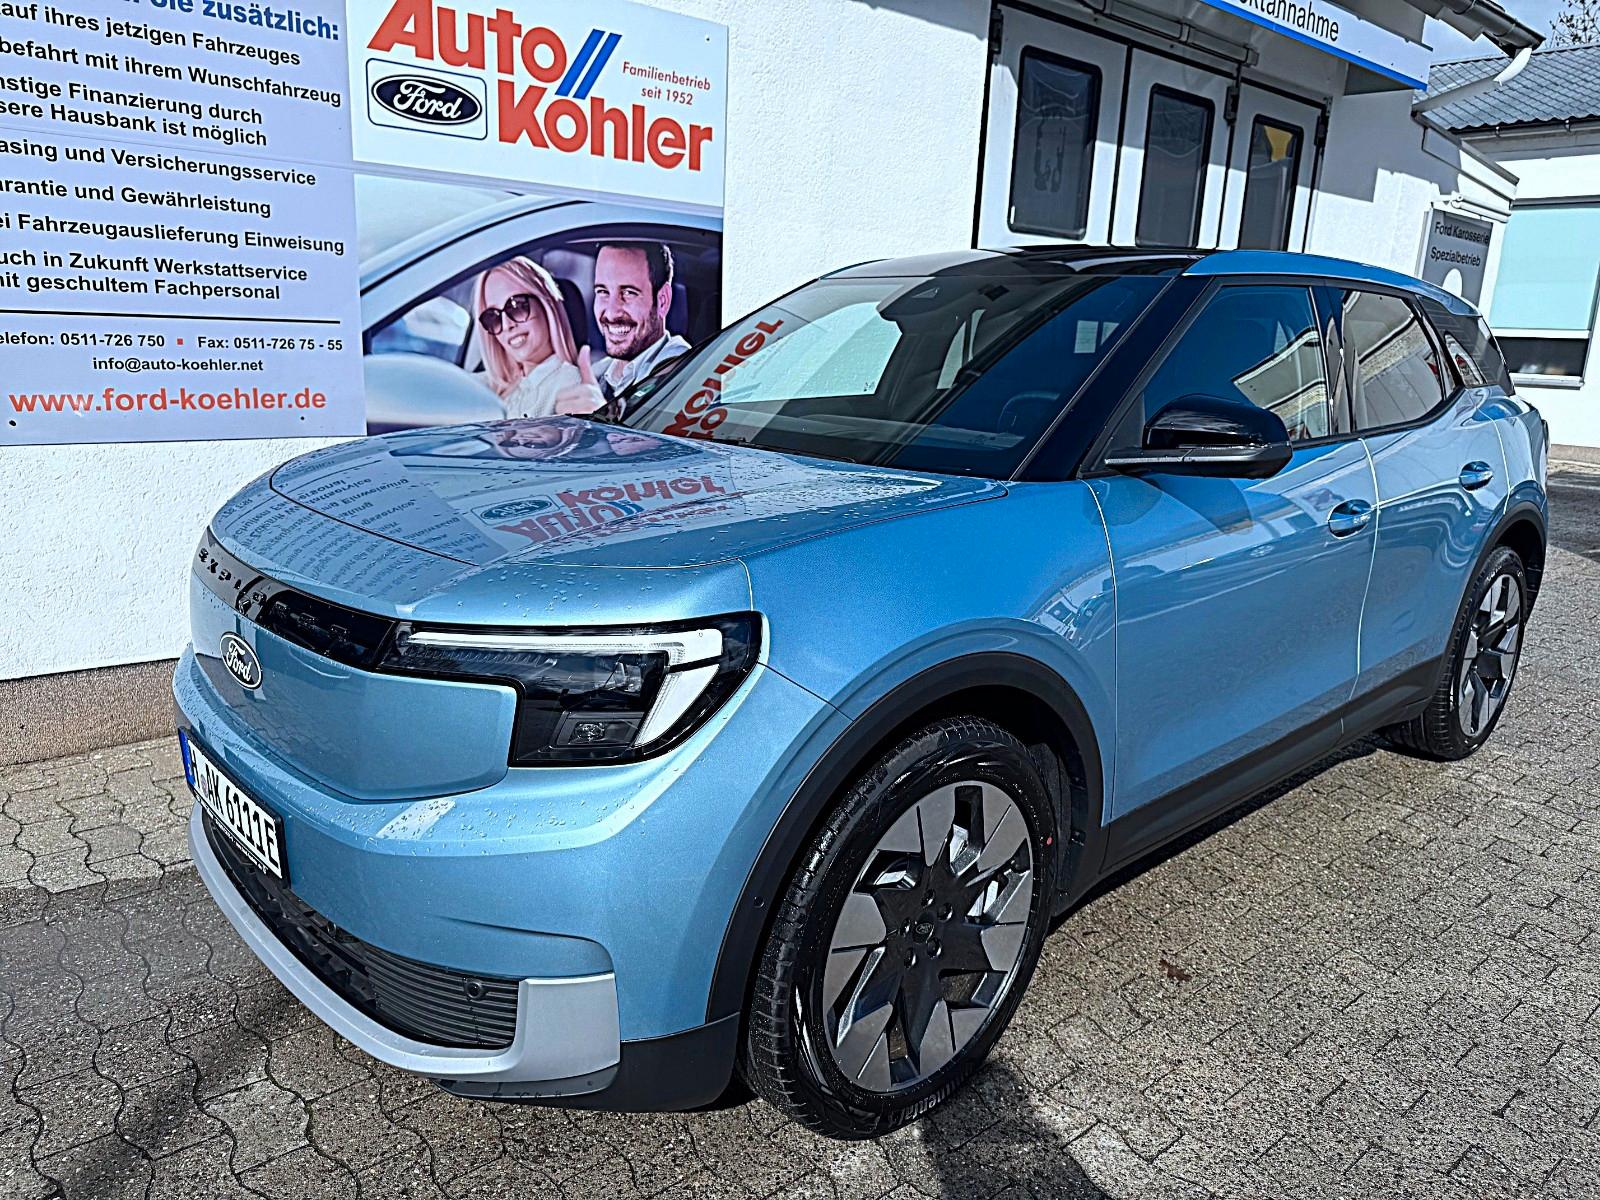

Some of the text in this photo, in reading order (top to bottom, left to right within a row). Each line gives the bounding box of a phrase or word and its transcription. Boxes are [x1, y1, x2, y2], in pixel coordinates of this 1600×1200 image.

[0, 3, 301, 65] auf ihres jetzigen Fahrzeuges
[203, 0, 339, 40] zusätzlich:
[366, 0, 568, 83] Auto
[86, 53, 118, 70] mit
[125, 57, 182, 80] ihrem
[188, 67, 341, 107] Wunschfahrzeug
[622, 61, 712, 91] Familienbetrieb
[69, 83, 202, 118] Finanzierung
[209, 106, 262, 124] durch
[393, 80, 463, 120] Ford
[641, 87, 694, 106] seit 1952
[51, 104, 156, 132] Hausbank
[163, 119, 186, 136] ist
[193, 125, 267, 146] möglich
[65, 148, 105, 162] und
[111, 149, 316, 186] Versicherungsservice
[75, 185, 114, 201] und
[121, 188, 271, 218] Gewährleistung
[18, 214, 238, 248] Fahrzeugauslieferung
[245, 232, 344, 256] Einweisung
[1434, 221, 1490, 245] Ford Karosserie
[44, 252, 63, 267] in
[70, 253, 149, 272] Zukunft
[154, 258, 307, 280] Werkstattservice
[1430, 246, 1482, 267] Spezialbetrieb
[27, 275, 148, 294] geschultem
[155, 280, 280, 299] Fachpersonal
[61, 334, 133, 347] 0511-726
[138, 335, 165, 347] 750
[198, 336, 229, 349] Fax:
[234, 337, 295, 350] 0511-726
[299, 338, 315, 350] 75
[327, 339, 343, 351] 55
[93, 357, 264, 373] info@auto-koehler.net
[9, 388, 327, 412] www.ford-koehler.de
[225, 638, 253, 683] Ford
[205, 763, 225, 816] AK
[226, 785, 280, 869] 6111E
